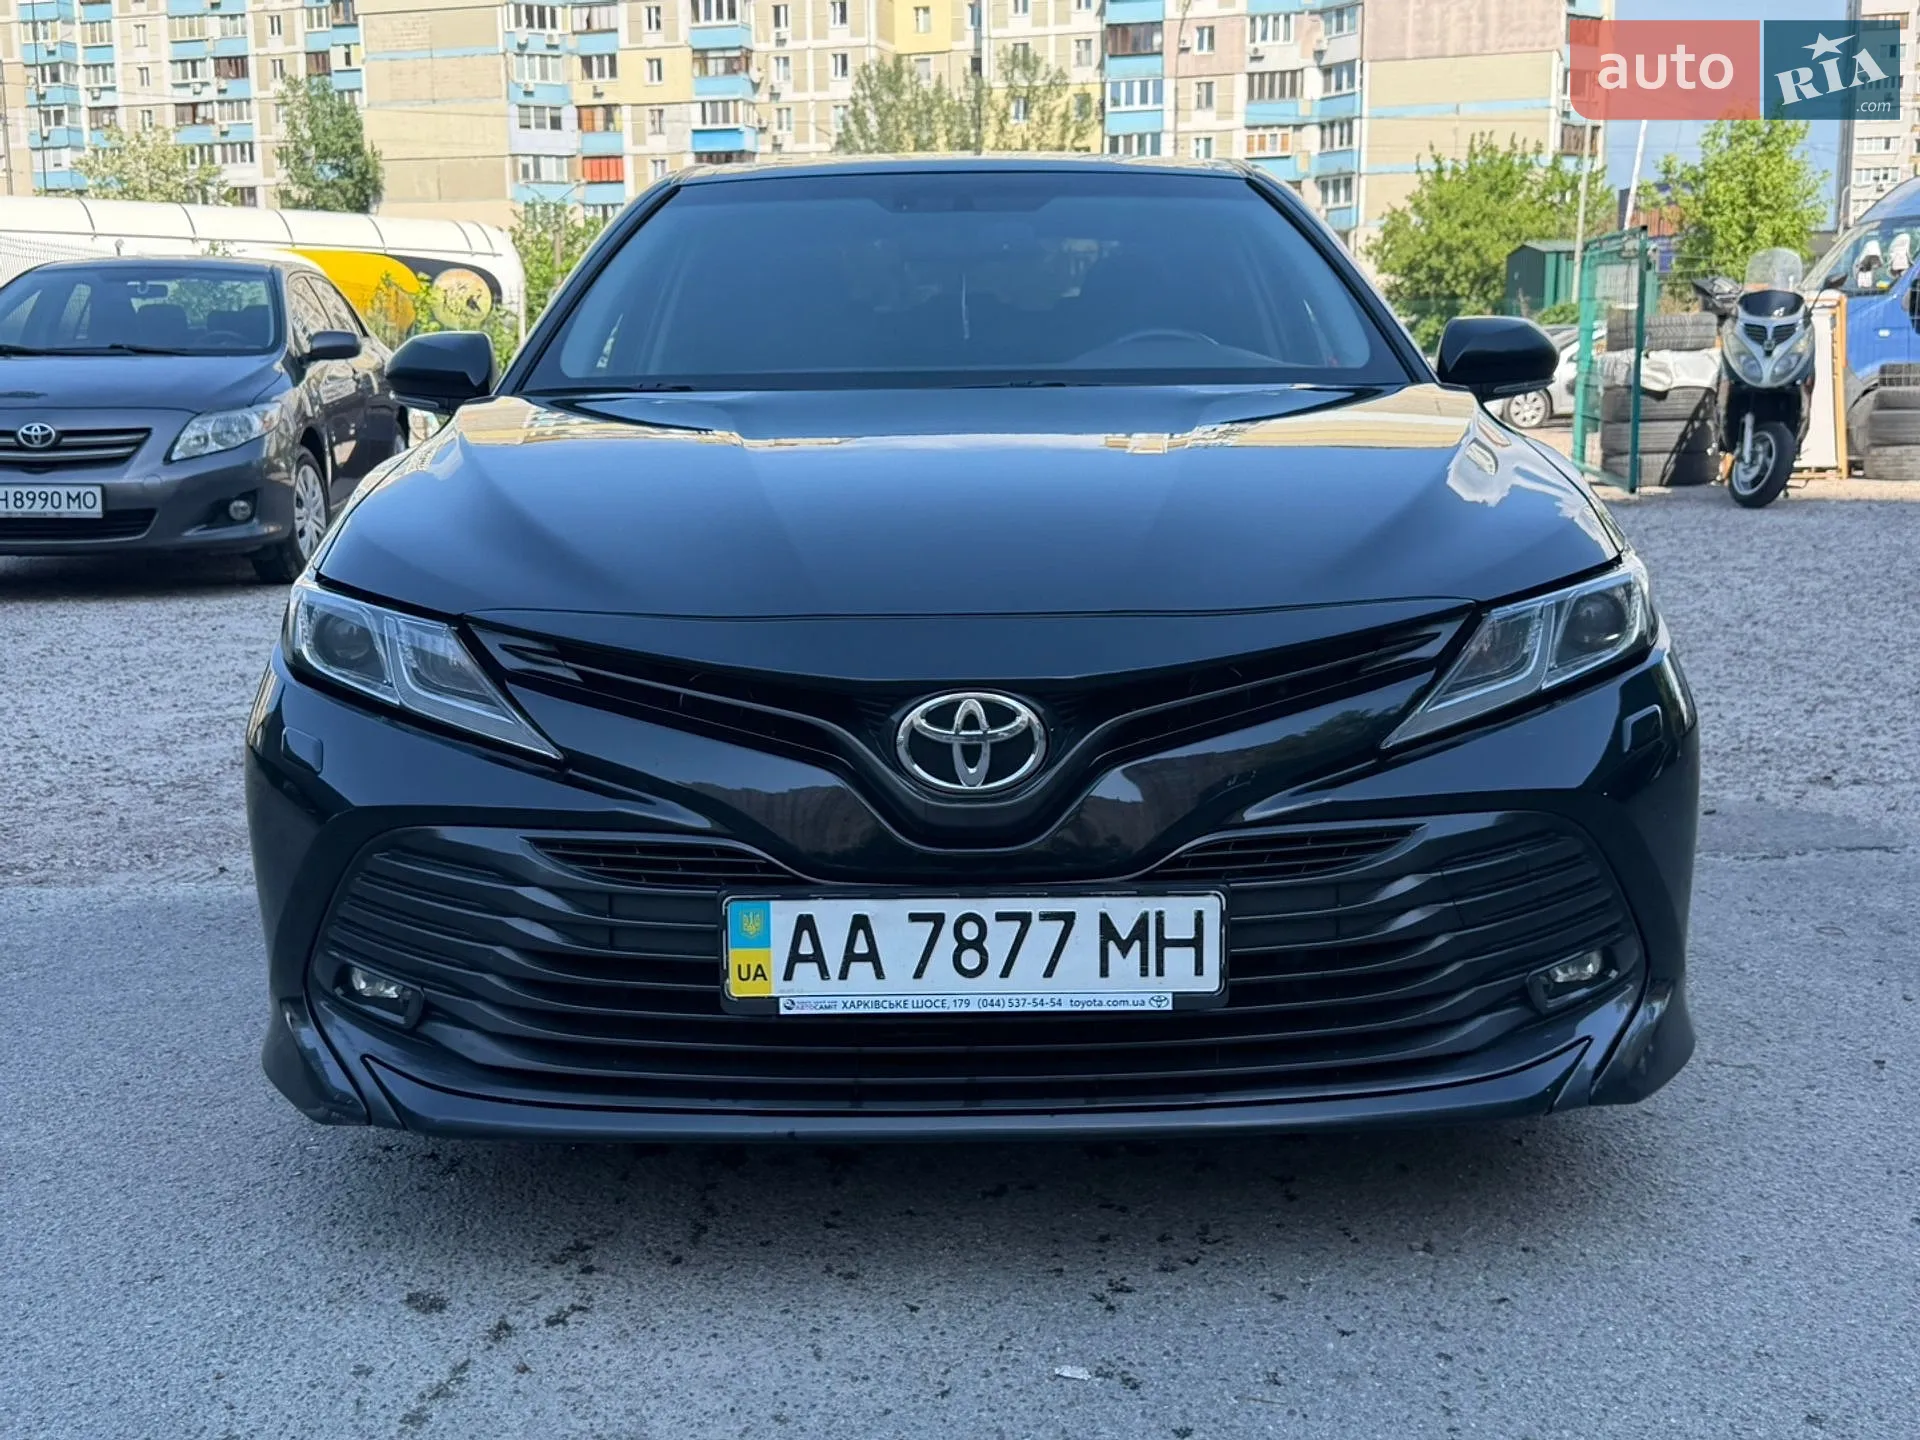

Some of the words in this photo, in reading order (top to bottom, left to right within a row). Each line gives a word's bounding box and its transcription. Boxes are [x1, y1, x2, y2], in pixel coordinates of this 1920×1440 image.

[13, 490, 62, 510] 8990
[66, 490, 97, 510] MO
[782, 913, 886, 982] AA
[907, 910, 1076, 980] 7877
[1099, 909, 1205, 979] MH
[737, 963, 768, 982] UA
[841, 998, 908, 1010] ХАРКІВСЬКЕ
[911, 998, 951, 1011] ШОСЕ,
[953, 998, 970, 1008] 179
[977, 998, 1006, 1009] (044)
[1007, 997, 1063, 1008] 537-54-54
[1069, 997, 1146, 1010] toyota.com.ua
